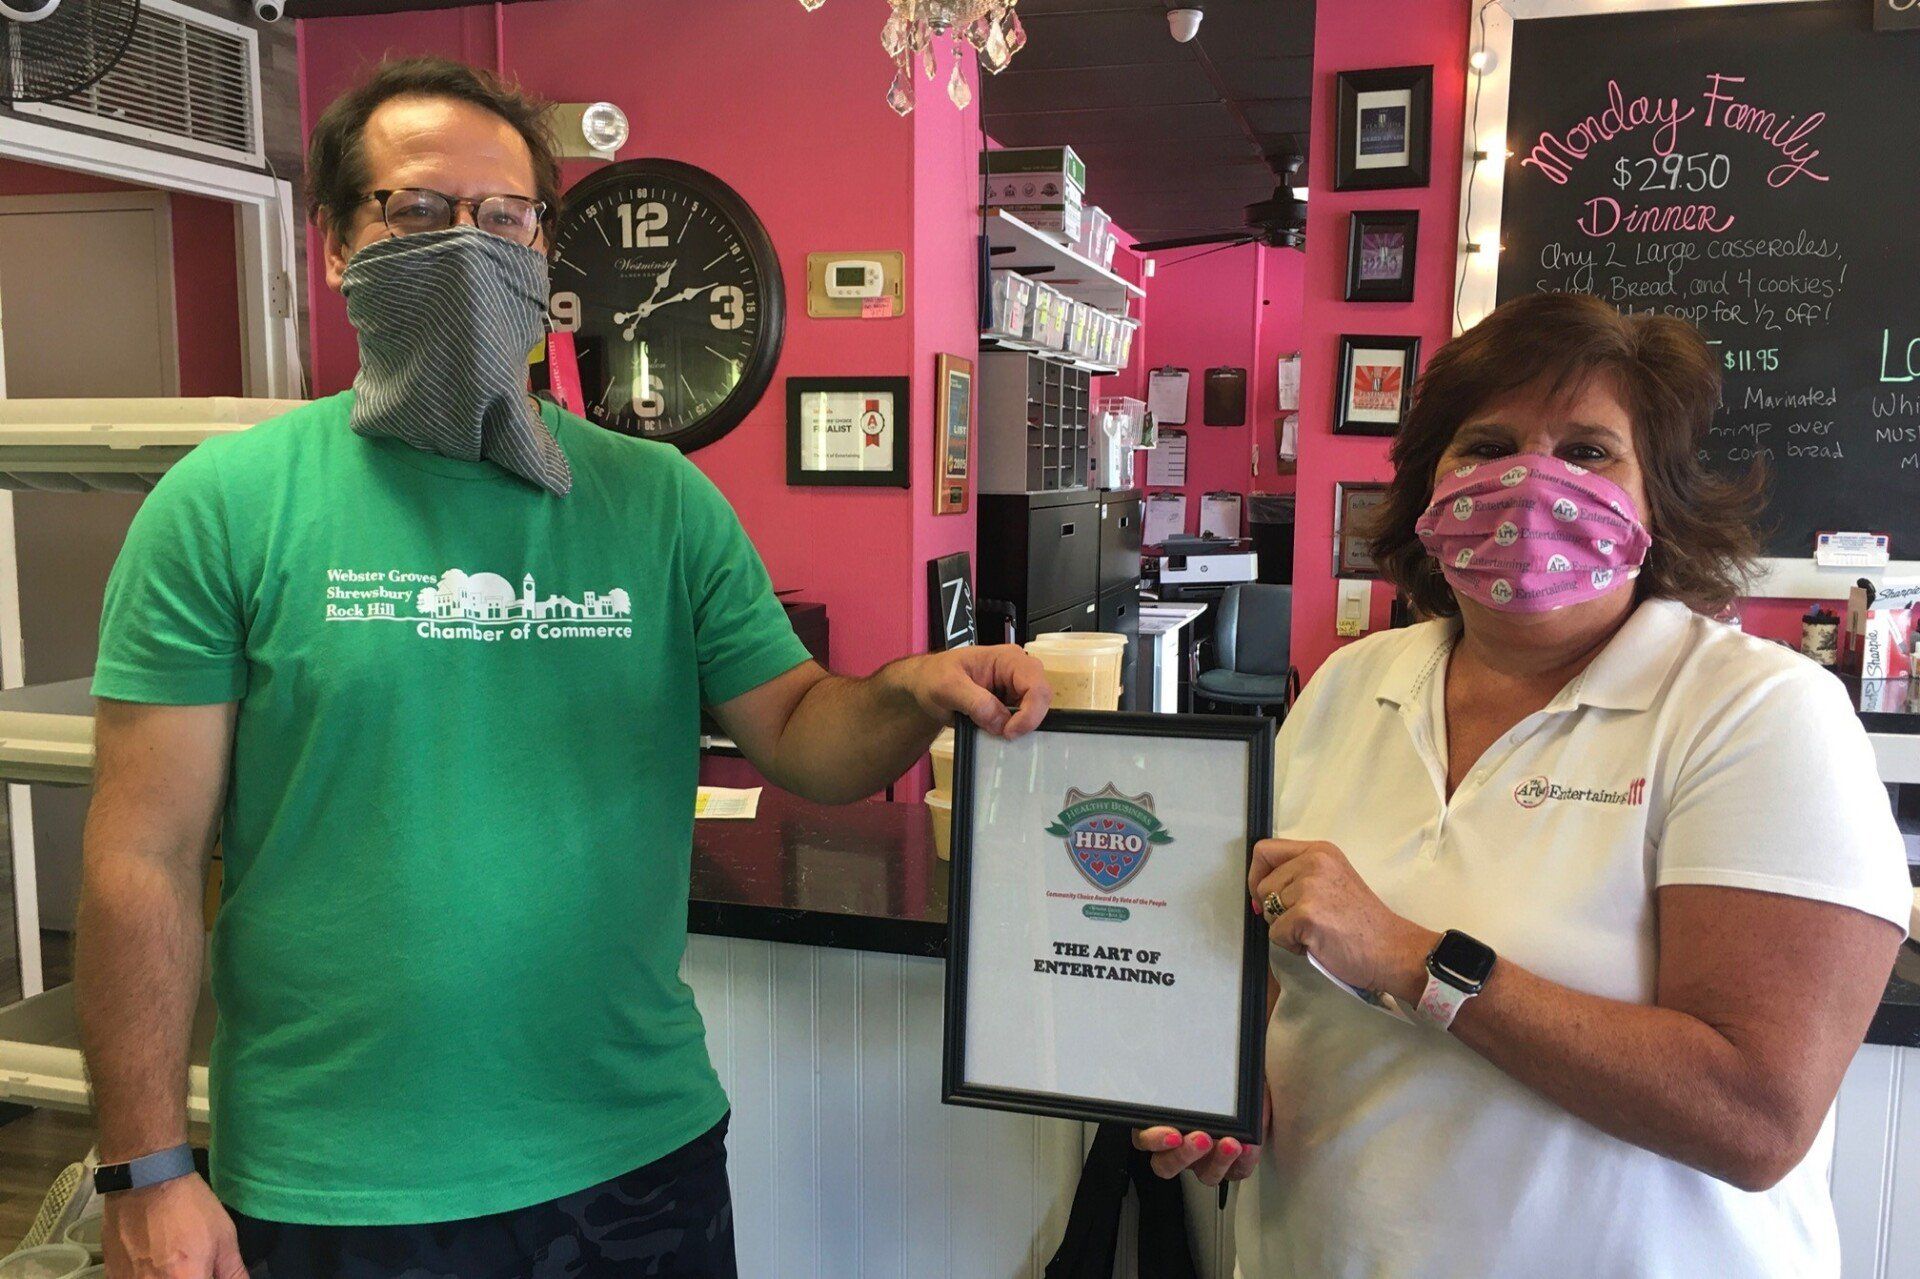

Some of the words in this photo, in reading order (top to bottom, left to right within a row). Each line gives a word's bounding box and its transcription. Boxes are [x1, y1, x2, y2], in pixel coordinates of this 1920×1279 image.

[1522, 80, 1695, 186] Monday
[1703, 73, 1830, 188] Family
[1613, 153, 1730, 192] $29.50
[617, 201, 669, 248] 12
[1605, 242, 1627, 267] 2
[1689, 270, 1730, 296] and
[1738, 268, 1751, 298] 4
[551, 291, 582, 333] 9
[710, 286, 745, 330] 3
[1724, 348, 1779, 372] $11.95
[632, 375, 665, 418] 6
[1744, 386, 1837, 410] Marinated
[813, 425, 852, 433] FALIST
[1788, 420, 1835, 436] over
[1727, 447, 1775, 461] corn
[1787, 441, 1844, 460] bread
[1554, 503, 1573, 518] Art
[327, 569, 385, 584] Webster
[388, 569, 437, 584] Groves
[326, 586, 413, 602] Shrewsbury
[326, 603, 364, 617] Rock
[367, 602, 395, 616] Hill
[416, 622, 503, 641] Chamber
[510, 624, 531, 641] of
[536, 623, 632, 639] Commerce
[1075, 831, 1143, 852] HERO
[1053, 942, 1089, 957] THE
[1093, 946, 1133, 962] ART
[1136, 949, 1161, 964] OF
[1034, 959, 1176, 987] ENTERTAINING
